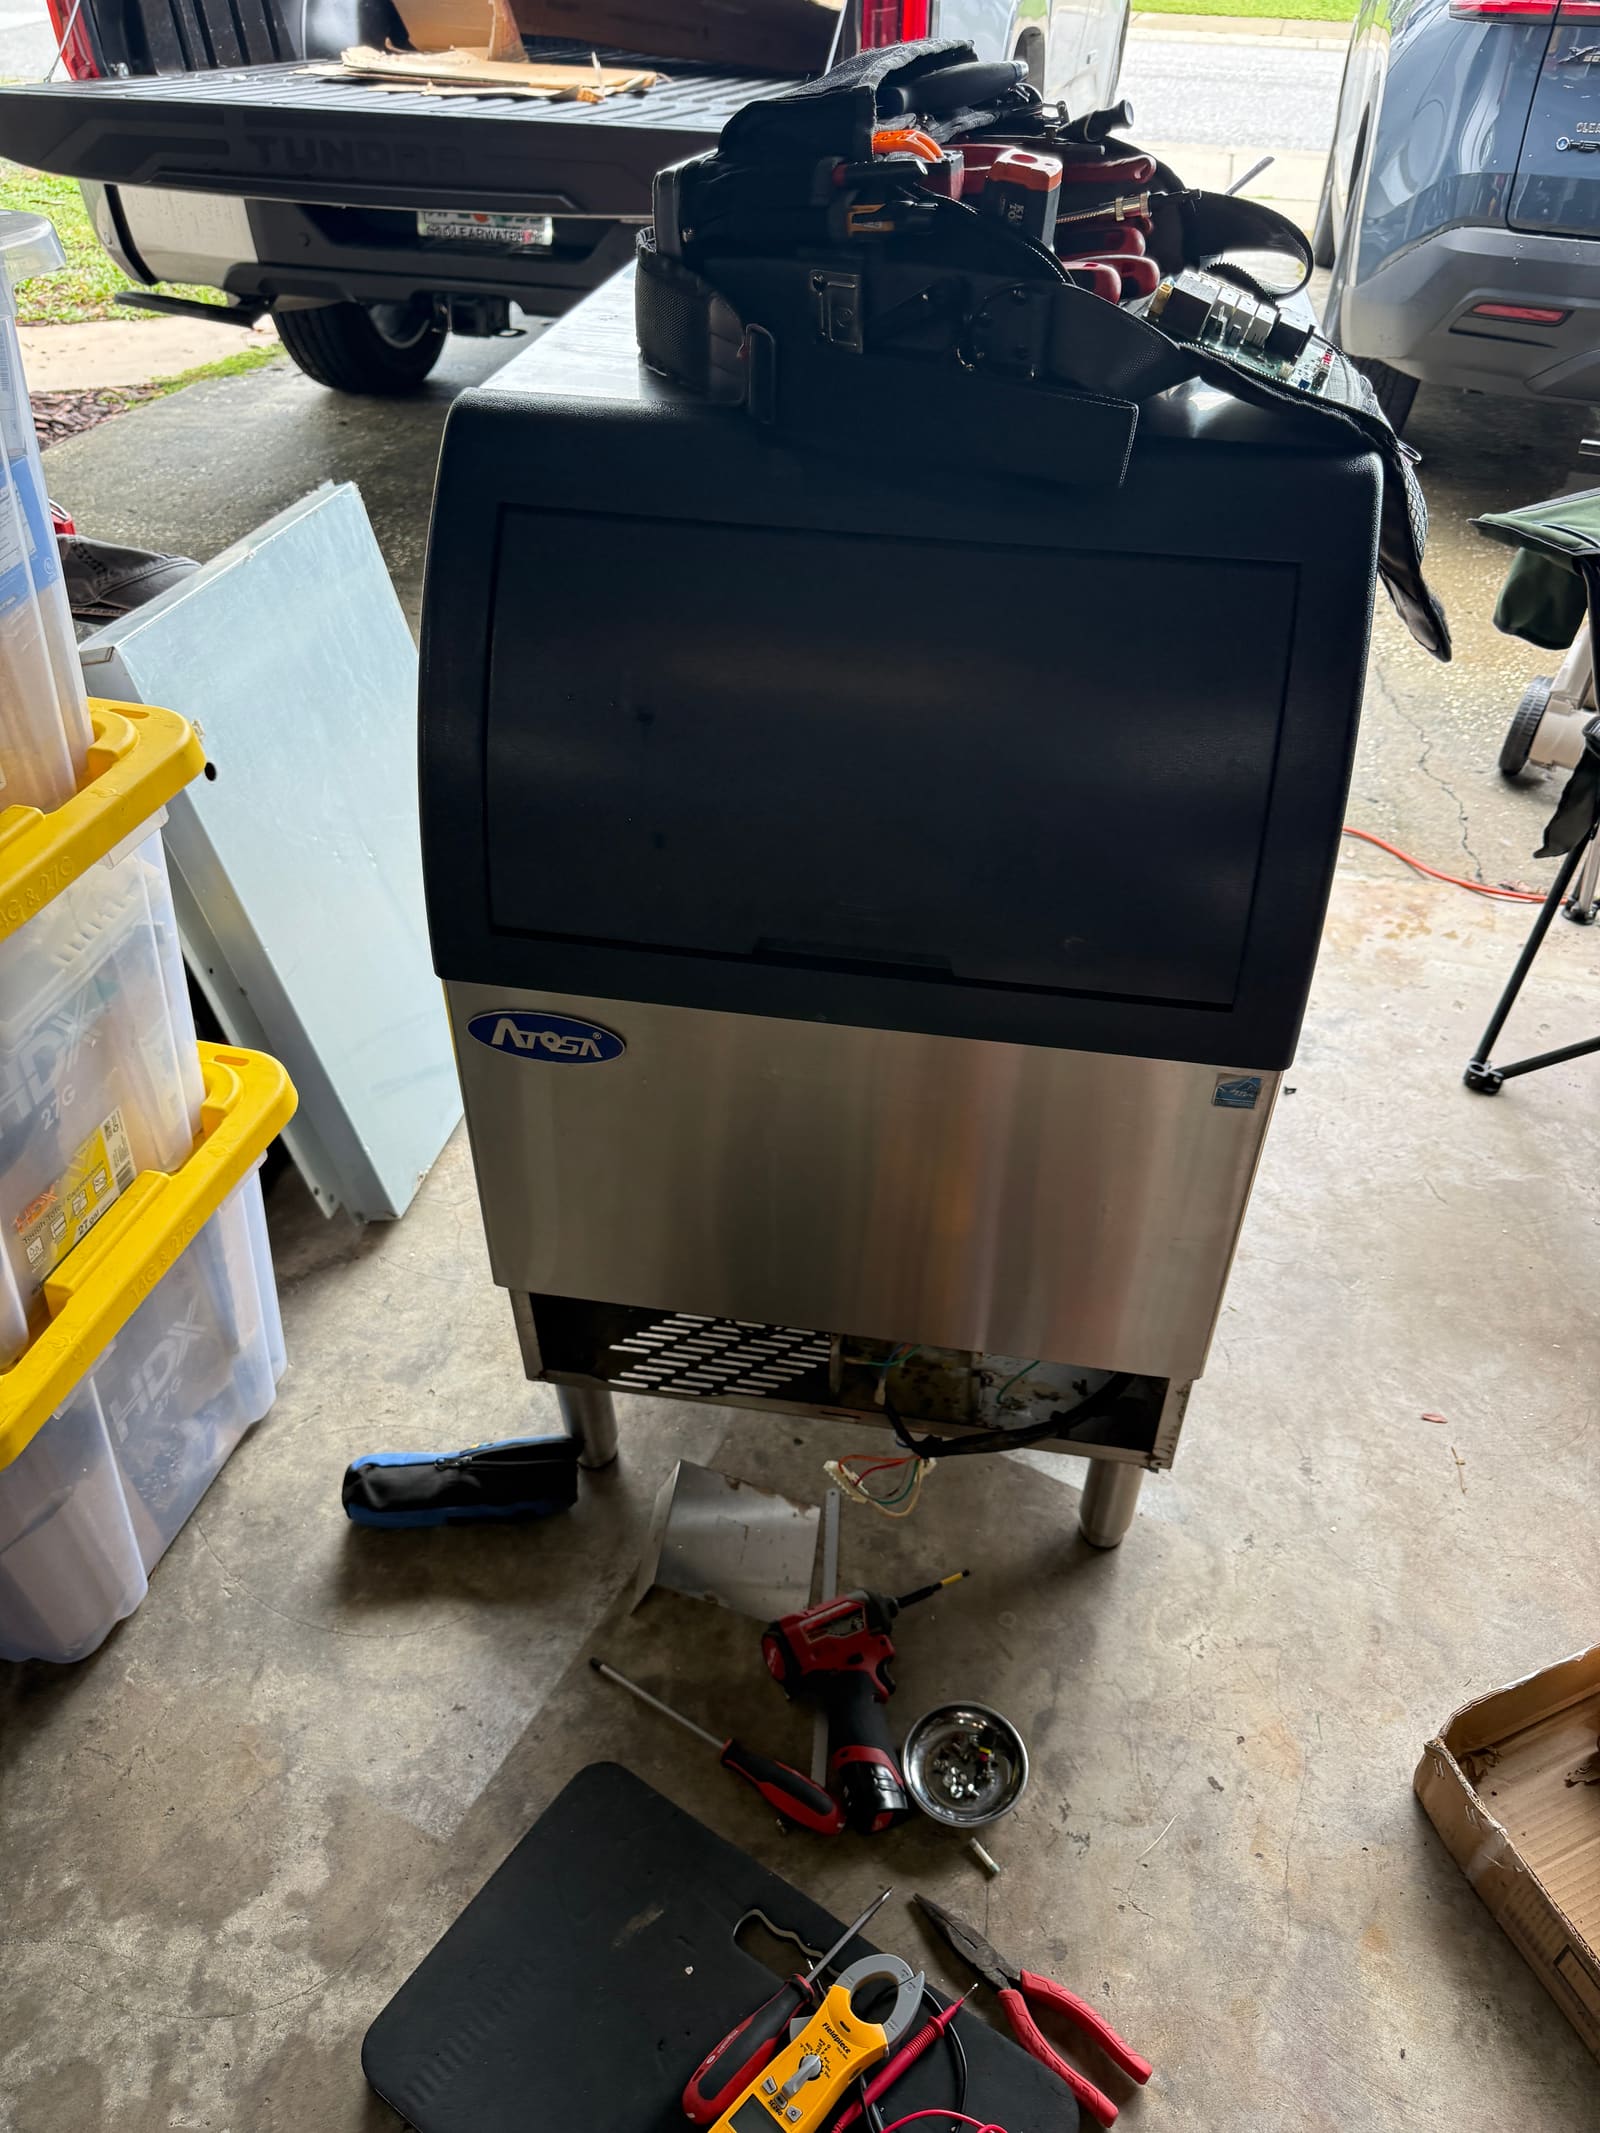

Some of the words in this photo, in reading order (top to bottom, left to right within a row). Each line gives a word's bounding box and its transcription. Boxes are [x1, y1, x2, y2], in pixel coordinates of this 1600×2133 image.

[246, 134, 465, 177] TUNDRA
[491, 1018, 602, 1058] ATOSA
[41, 1083, 76, 1131] 27G
[16, 1184, 58, 1234] HDX
[78, 1219, 89, 1235] 27
[110, 1293, 208, 1443] HDX
[822, 2022, 851, 2054] Fieldpiece
